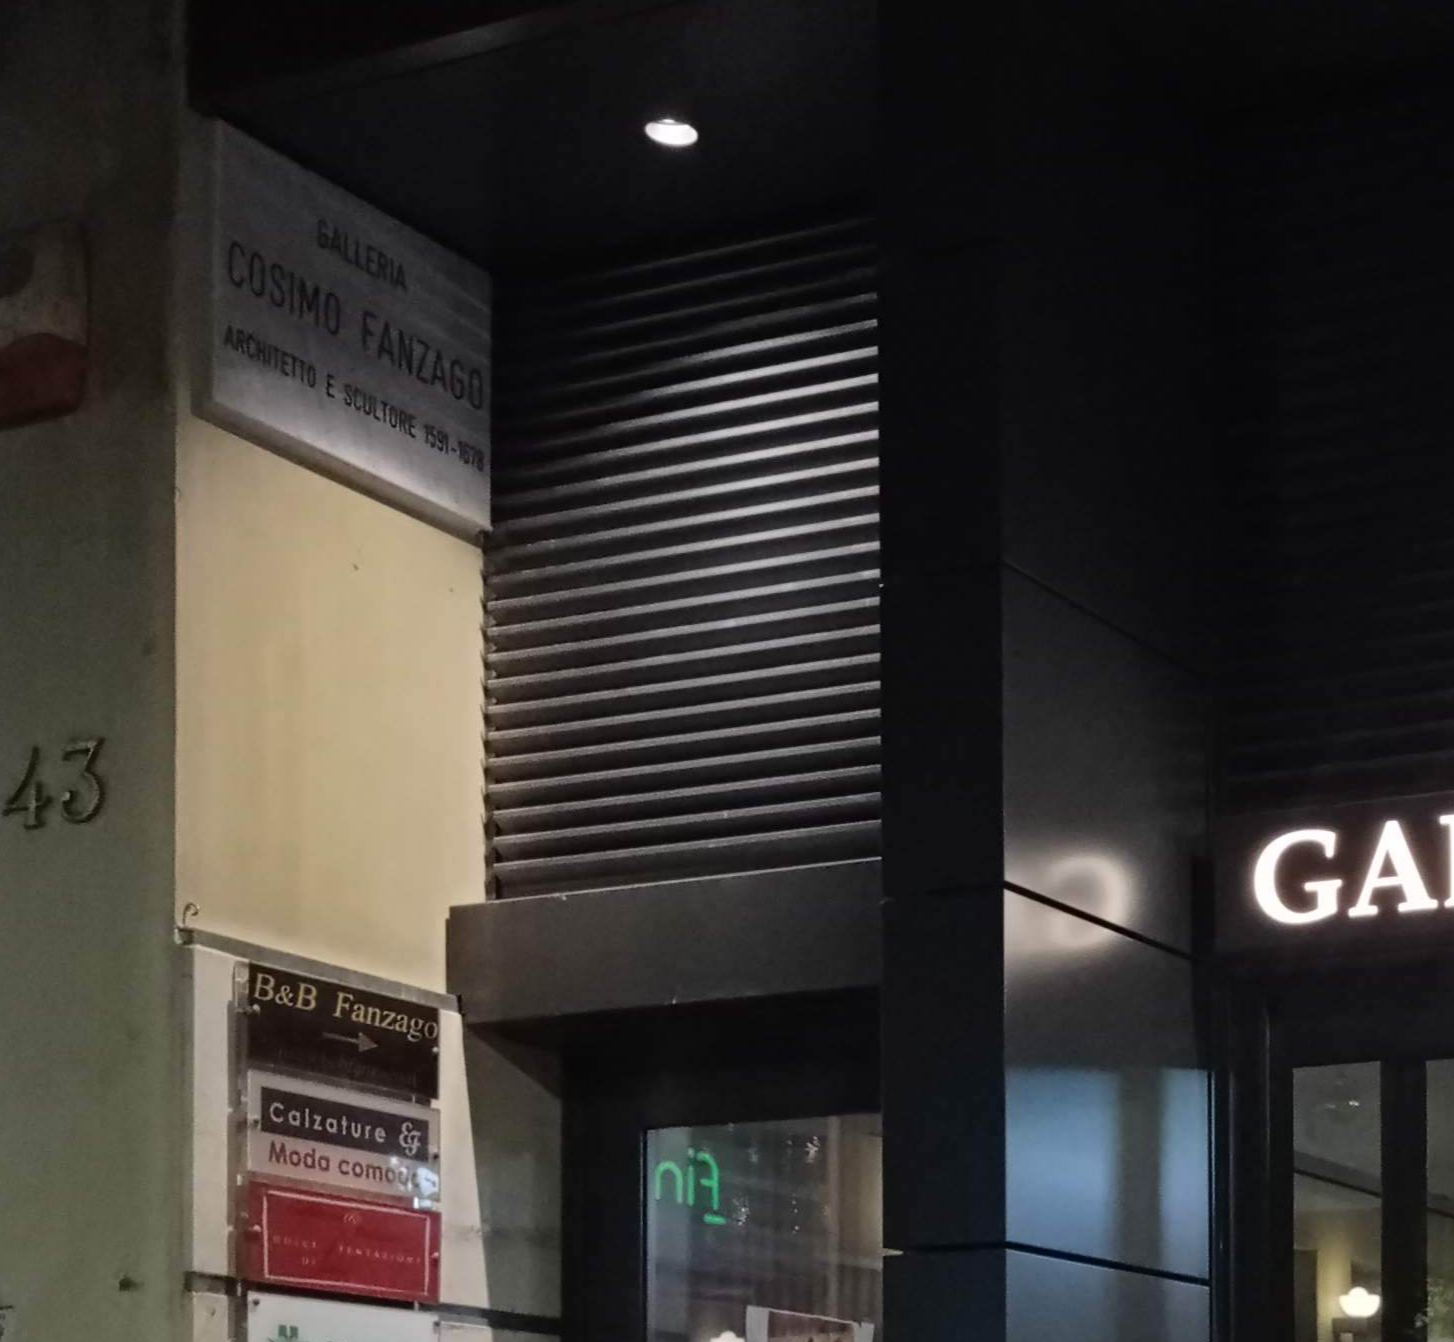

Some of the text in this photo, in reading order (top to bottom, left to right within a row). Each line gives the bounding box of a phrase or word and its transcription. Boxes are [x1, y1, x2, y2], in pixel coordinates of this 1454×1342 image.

[317, 218, 408, 292] GALLERIA
[226, 239, 484, 411] COSIMO FANZAGO
[223, 324, 317, 390] ARCHITETTO
[325, 373, 336, 399] E
[343, 383, 417, 439] SCULTORE
[2, 737, 105, 829] 43
[254, 972, 439, 1043] B&B Fanzago
[268, 1101, 387, 1144] Calzature
[268, 1139, 331, 1173] Moda
